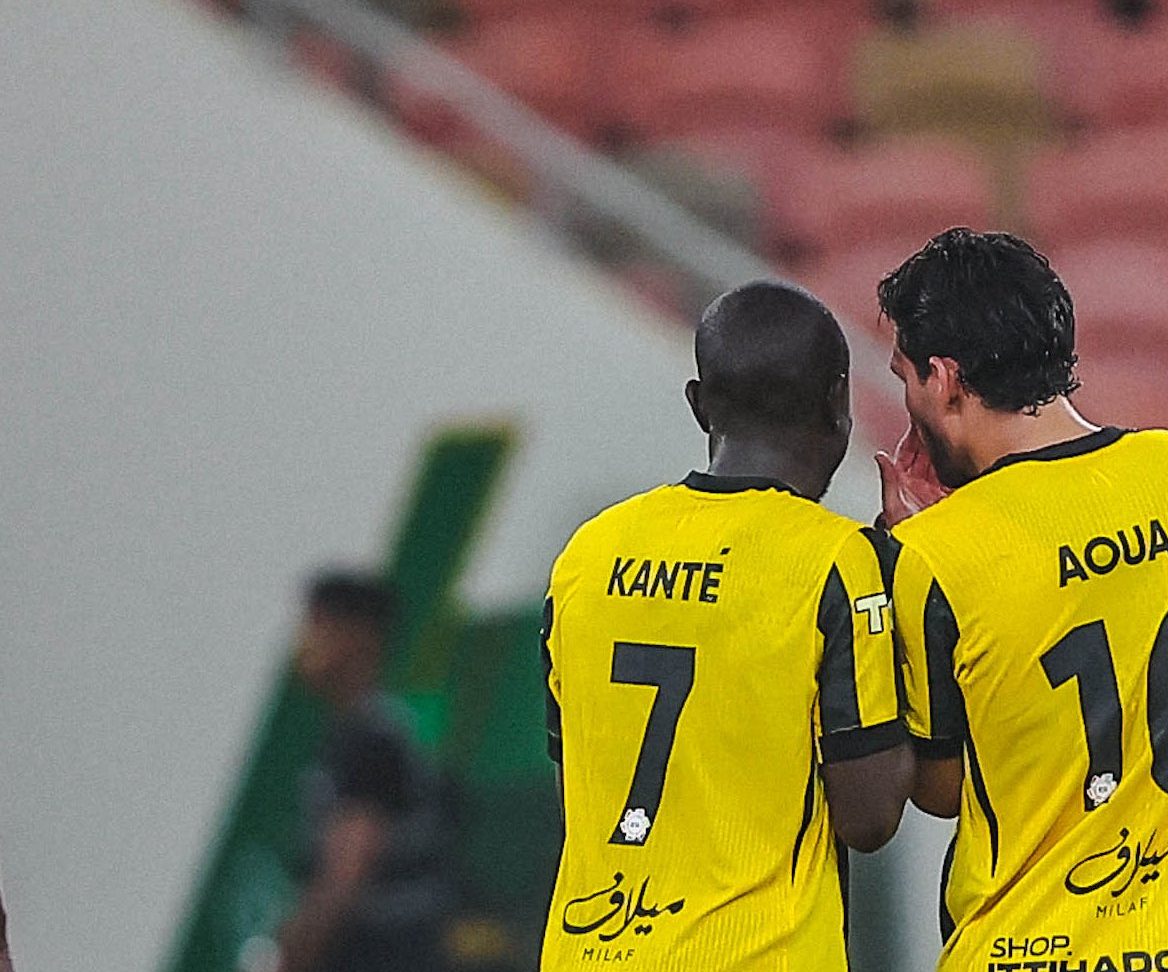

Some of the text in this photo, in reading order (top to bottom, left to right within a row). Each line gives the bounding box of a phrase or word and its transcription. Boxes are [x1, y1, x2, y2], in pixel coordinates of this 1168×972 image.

[606, 546, 732, 604] KANTÉ
[607, 641, 697, 847] 7
[1095, 899, 1149, 919] MILAF
[581, 947, 636, 962] MILAF
